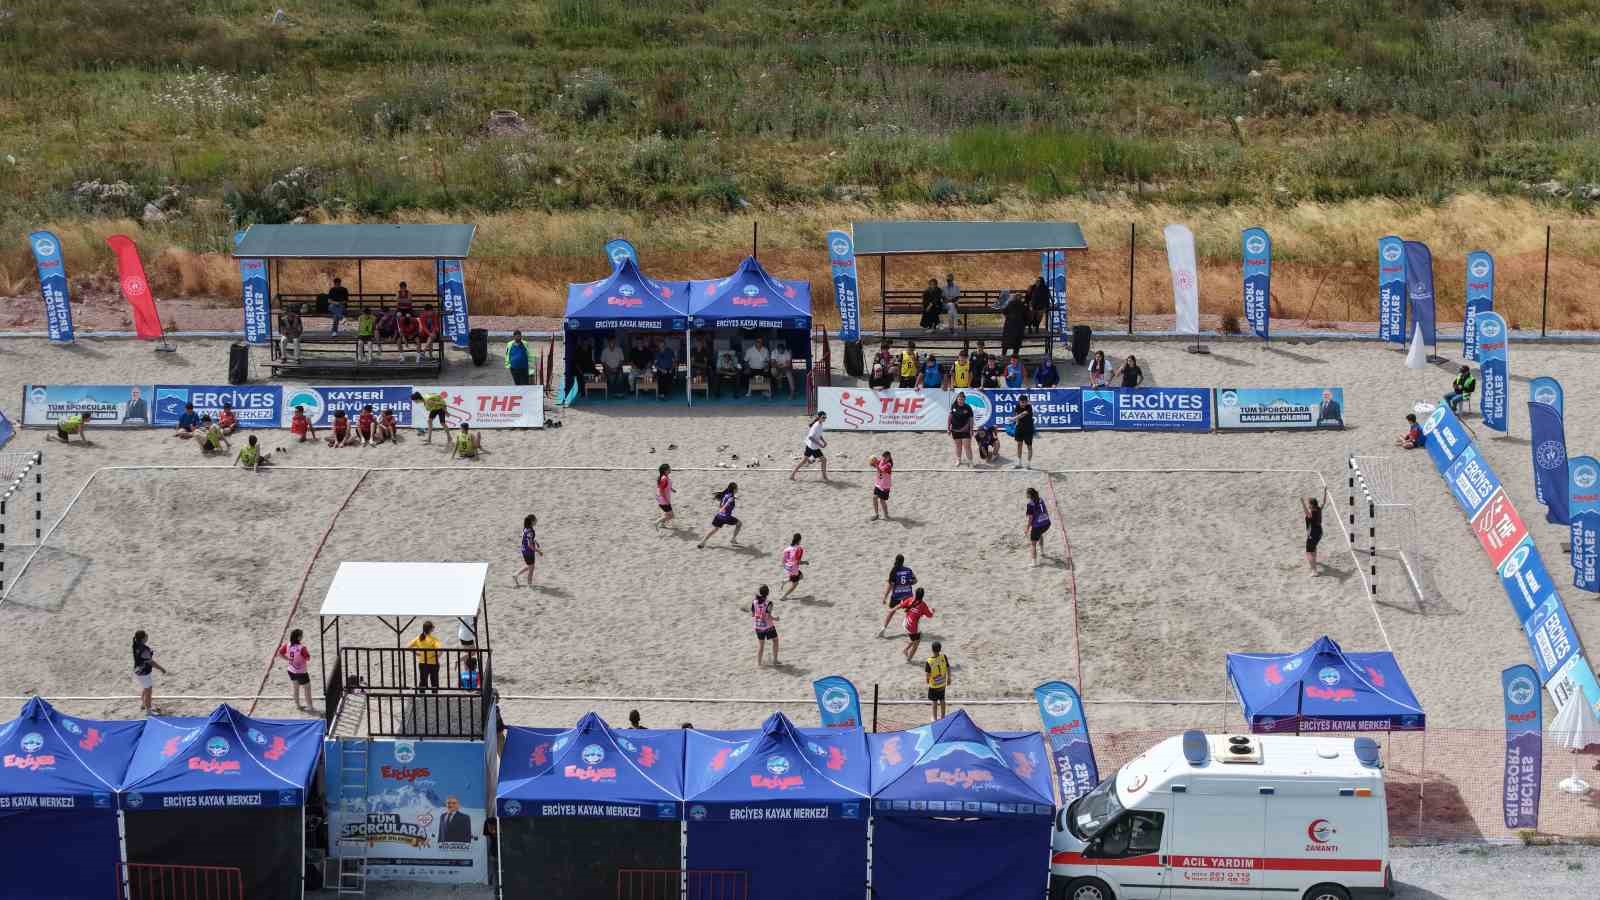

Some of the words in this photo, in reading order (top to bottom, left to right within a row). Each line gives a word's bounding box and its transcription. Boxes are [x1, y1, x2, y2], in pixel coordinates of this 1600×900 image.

[619, 320, 637, 328] KAYAK
[740, 319, 758, 327] KAYAK
[192, 391, 275, 408] ERCİYES
[328, 389, 384, 400] KAYSERİ
[995, 391, 1051, 402] KAYERİ
[1119, 392, 1203, 409] ERCİYES
[477, 395, 522, 411] THF
[879, 397, 925, 414] THF
[1121, 411, 1154, 420] KAYAK
[1157, 411, 1201, 421] MERKEZİ
[1464, 460, 1493, 498] ERCİYES
[1495, 512, 1517, 538] THF
[1545, 612, 1571, 660] ERCİYES
[1299, 720, 1331, 731] ERCİYES
[1332, 720, 1357, 730] KAYAK
[1358, 718, 1391, 730] MERKEZİ
[12, 797, 38, 808] KAYAK
[40, 795, 75, 808] MERKEZİ
[163, 794, 197, 808] ERCİYES
[198, 795, 226, 807] KAYAK
[226, 793, 262, 806] MERKEZİ
[542, 802, 576, 816] ERCİYES
[577, 805, 605, 816] KAYAK
[606, 805, 641, 817] MERKEZİ
[730, 807, 763, 820] ERCİYES
[765, 809, 791, 819] KAYAK
[793, 807, 829, 819] MERKEZİ
[370, 811, 396, 824] TÜM
[1211, 858, 1254, 868] YARDIM
